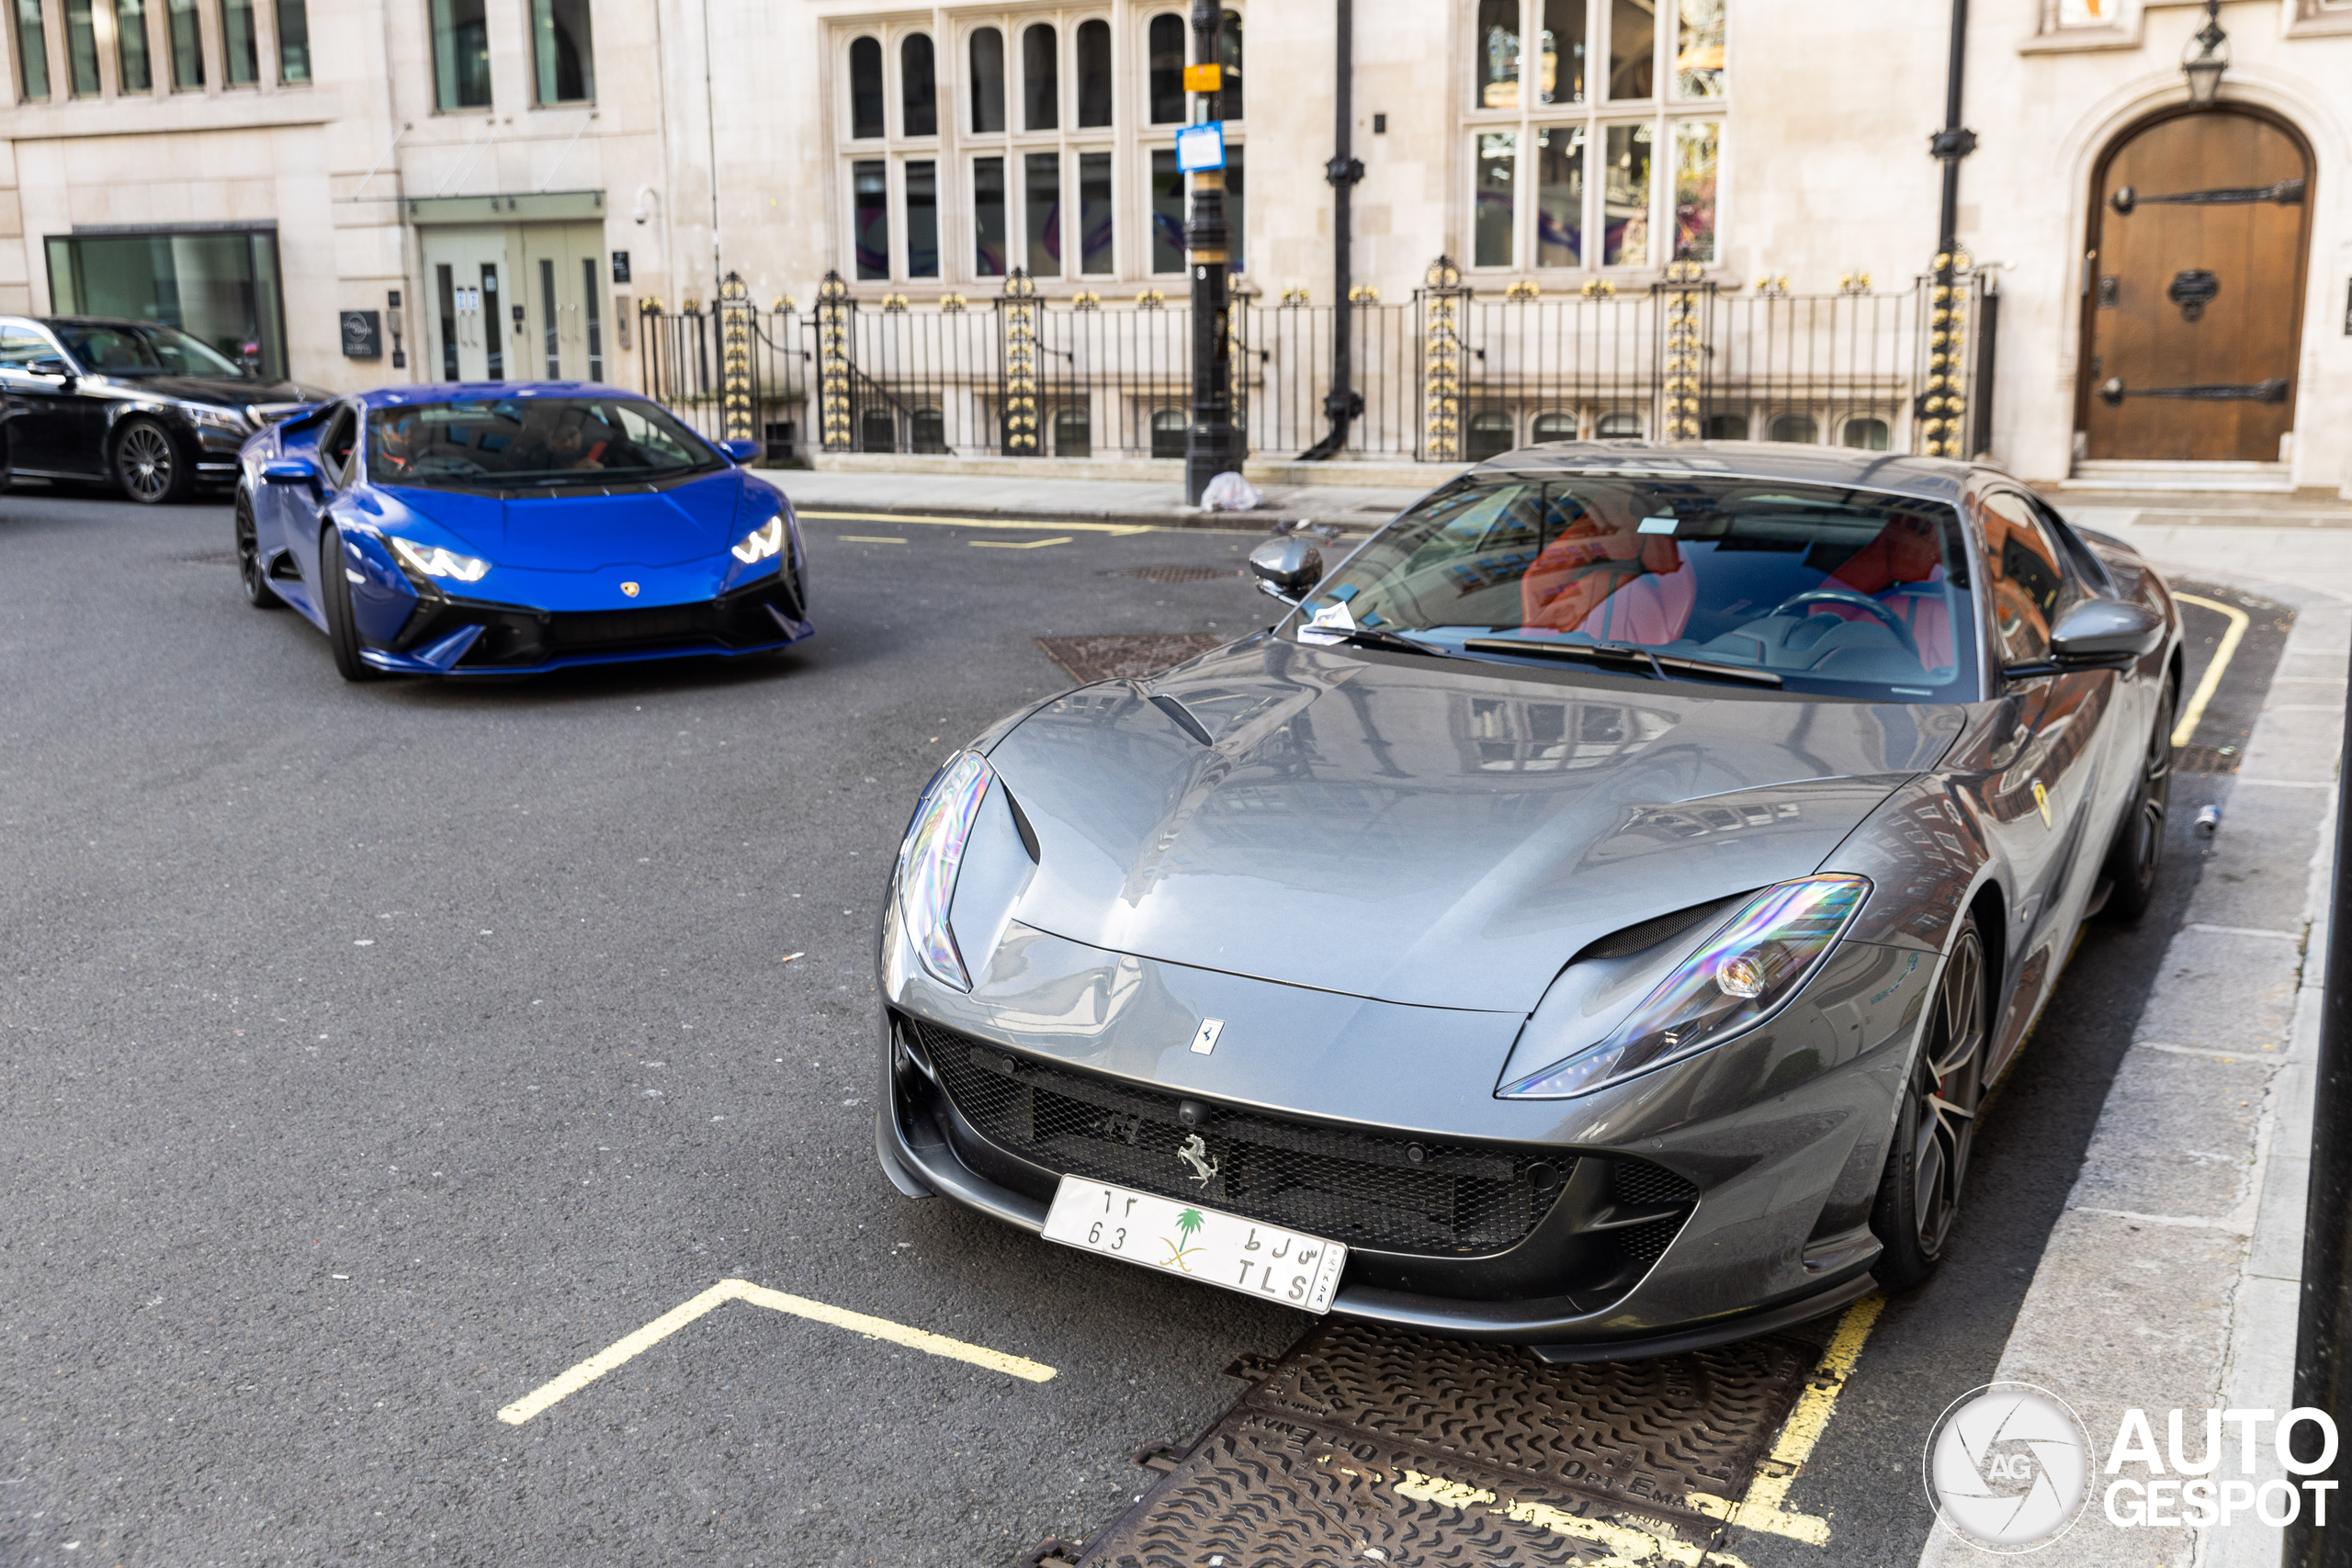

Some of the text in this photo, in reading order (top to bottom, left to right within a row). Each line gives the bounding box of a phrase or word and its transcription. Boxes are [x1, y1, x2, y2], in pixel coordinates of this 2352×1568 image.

[1088, 1221, 1127, 1250] 63
[1238, 1258, 1306, 1301] TLS
[1242, 1414, 1379, 1462] OPT-EMAX
